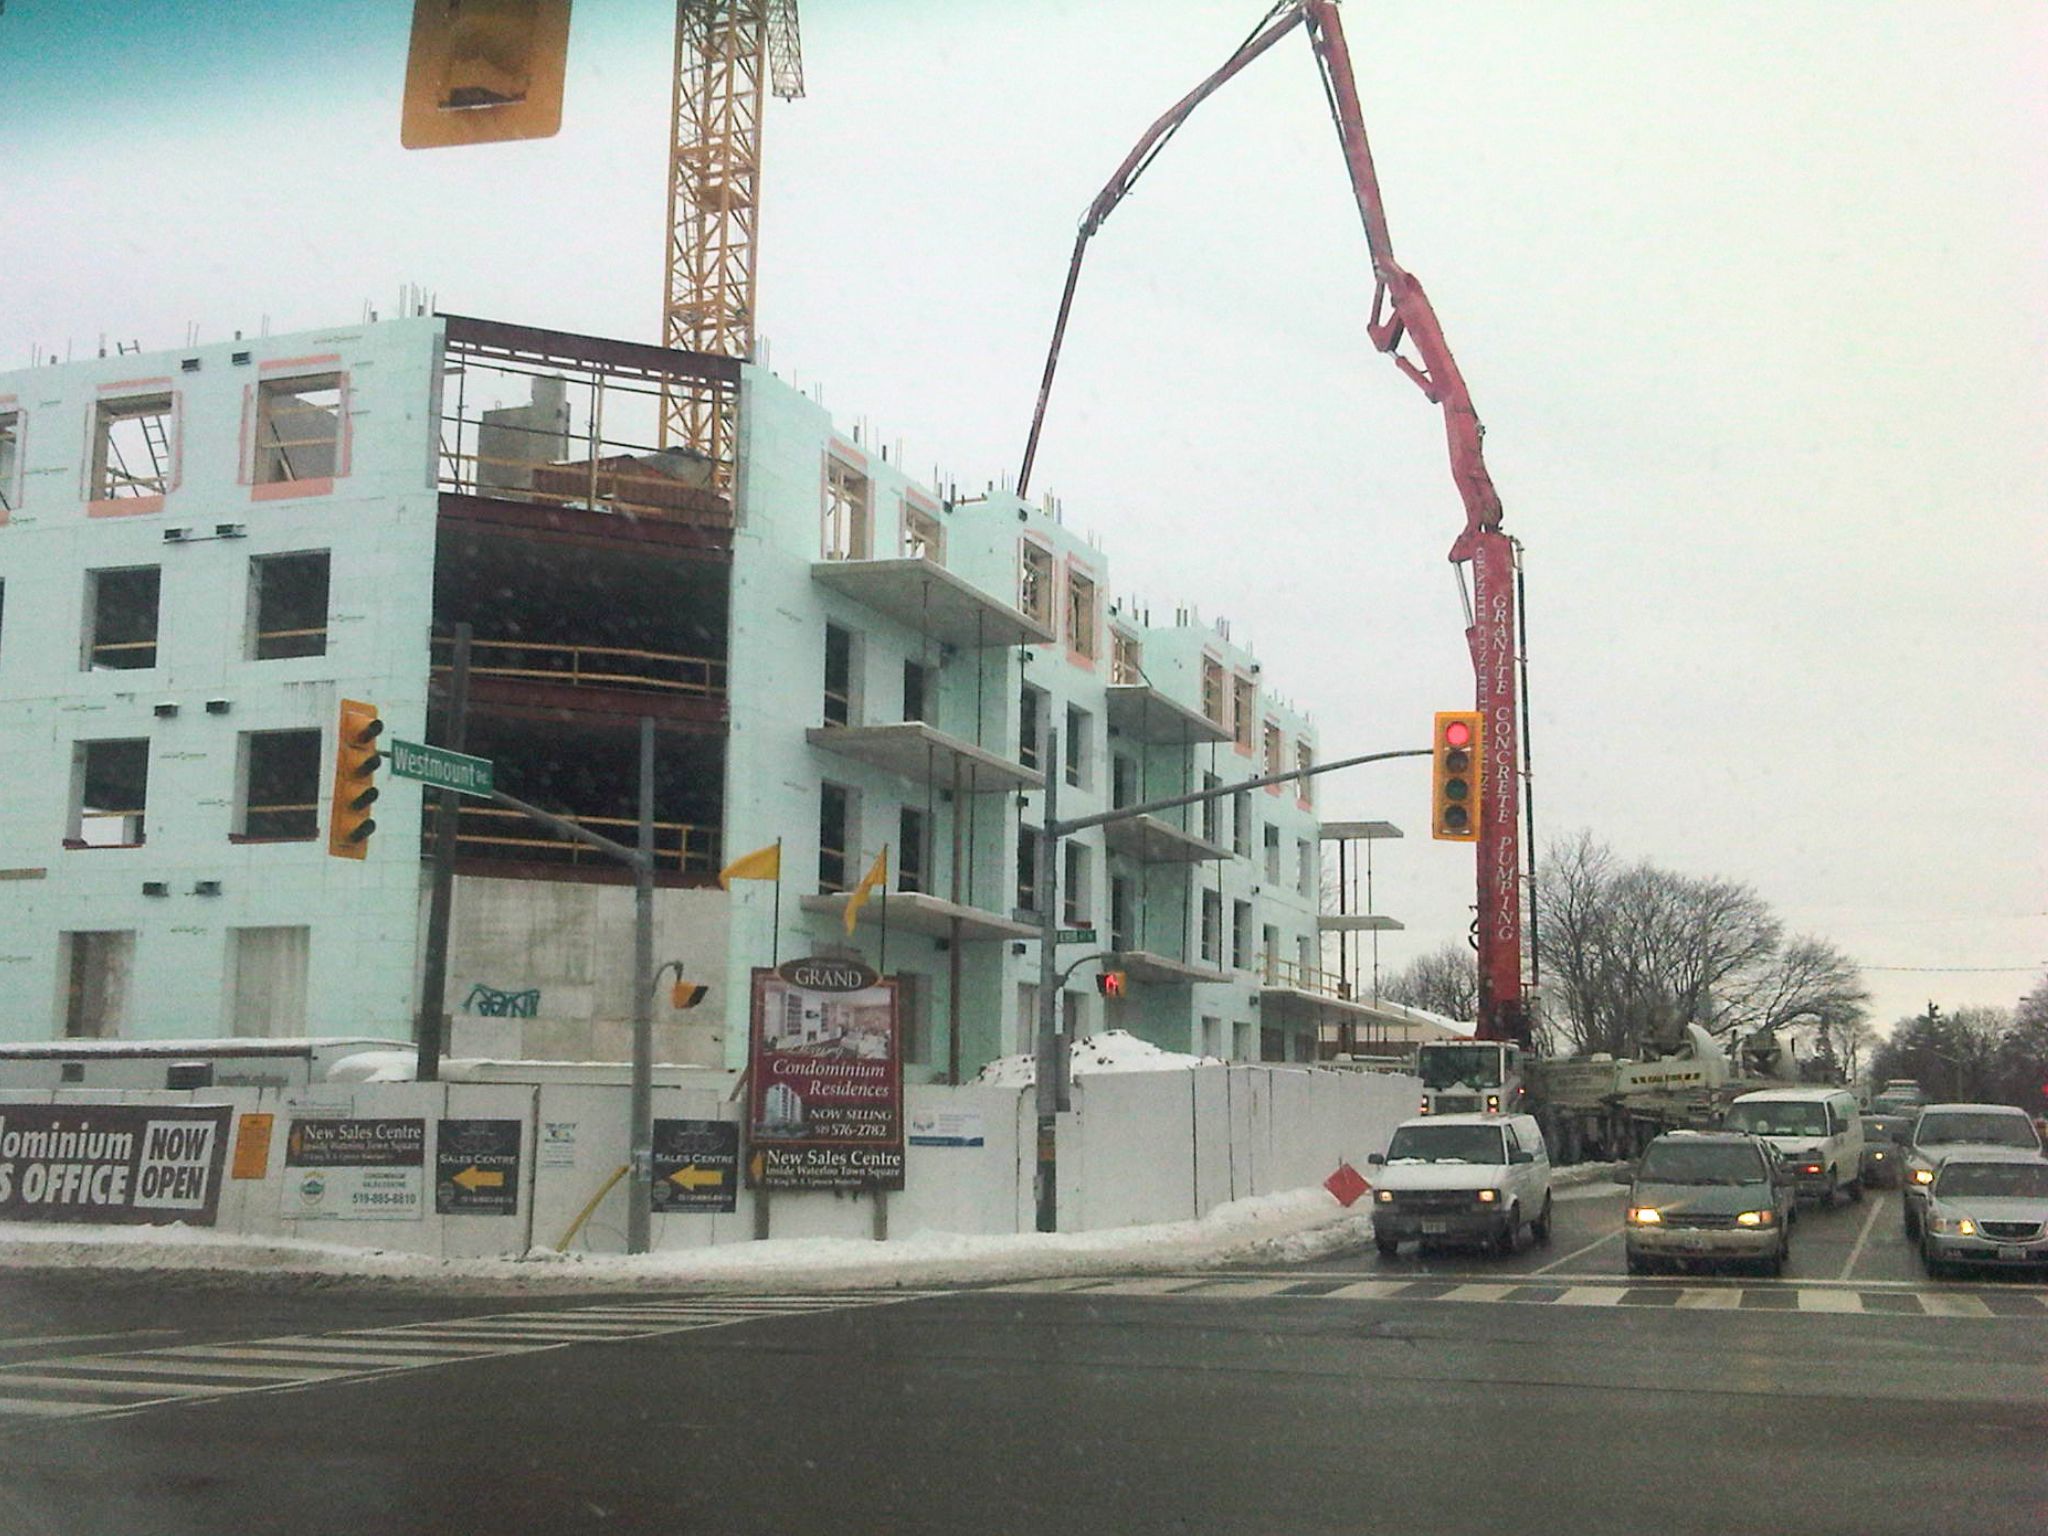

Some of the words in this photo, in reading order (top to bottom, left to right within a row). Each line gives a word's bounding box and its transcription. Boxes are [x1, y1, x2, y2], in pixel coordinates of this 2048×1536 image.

[1492, 594, 1509, 695] GRANITE
[394, 744, 474, 788] Westmount
[1495, 706, 1511, 824] CONCRETE
[1496, 836, 1516, 941] PUMPING
[795, 967, 862, 988] GRAND
[773, 1058, 886, 1079] Condominium
[809, 1079, 889, 1098] Residences
[809, 1108, 842, 1120] NOW
[0, 1115, 134, 1160] ominium
[304, 1124, 336, 1140] New
[338, 1124, 373, 1140] Sales
[376, 1124, 421, 1140] Centre
[831, 1123, 887, 1137] 576-2782
[148, 1127, 210, 1161] NOW
[767, 1149, 803, 1165] New
[807, 1149, 847, 1165] Sales
[851, 1150, 900, 1166] Centre
[22, 1163, 130, 1205] OFFICE
[141, 1165, 204, 1200] OPEN
[841, 1166, 865, 1176] Town
[868, 1166, 900, 1179] Square
